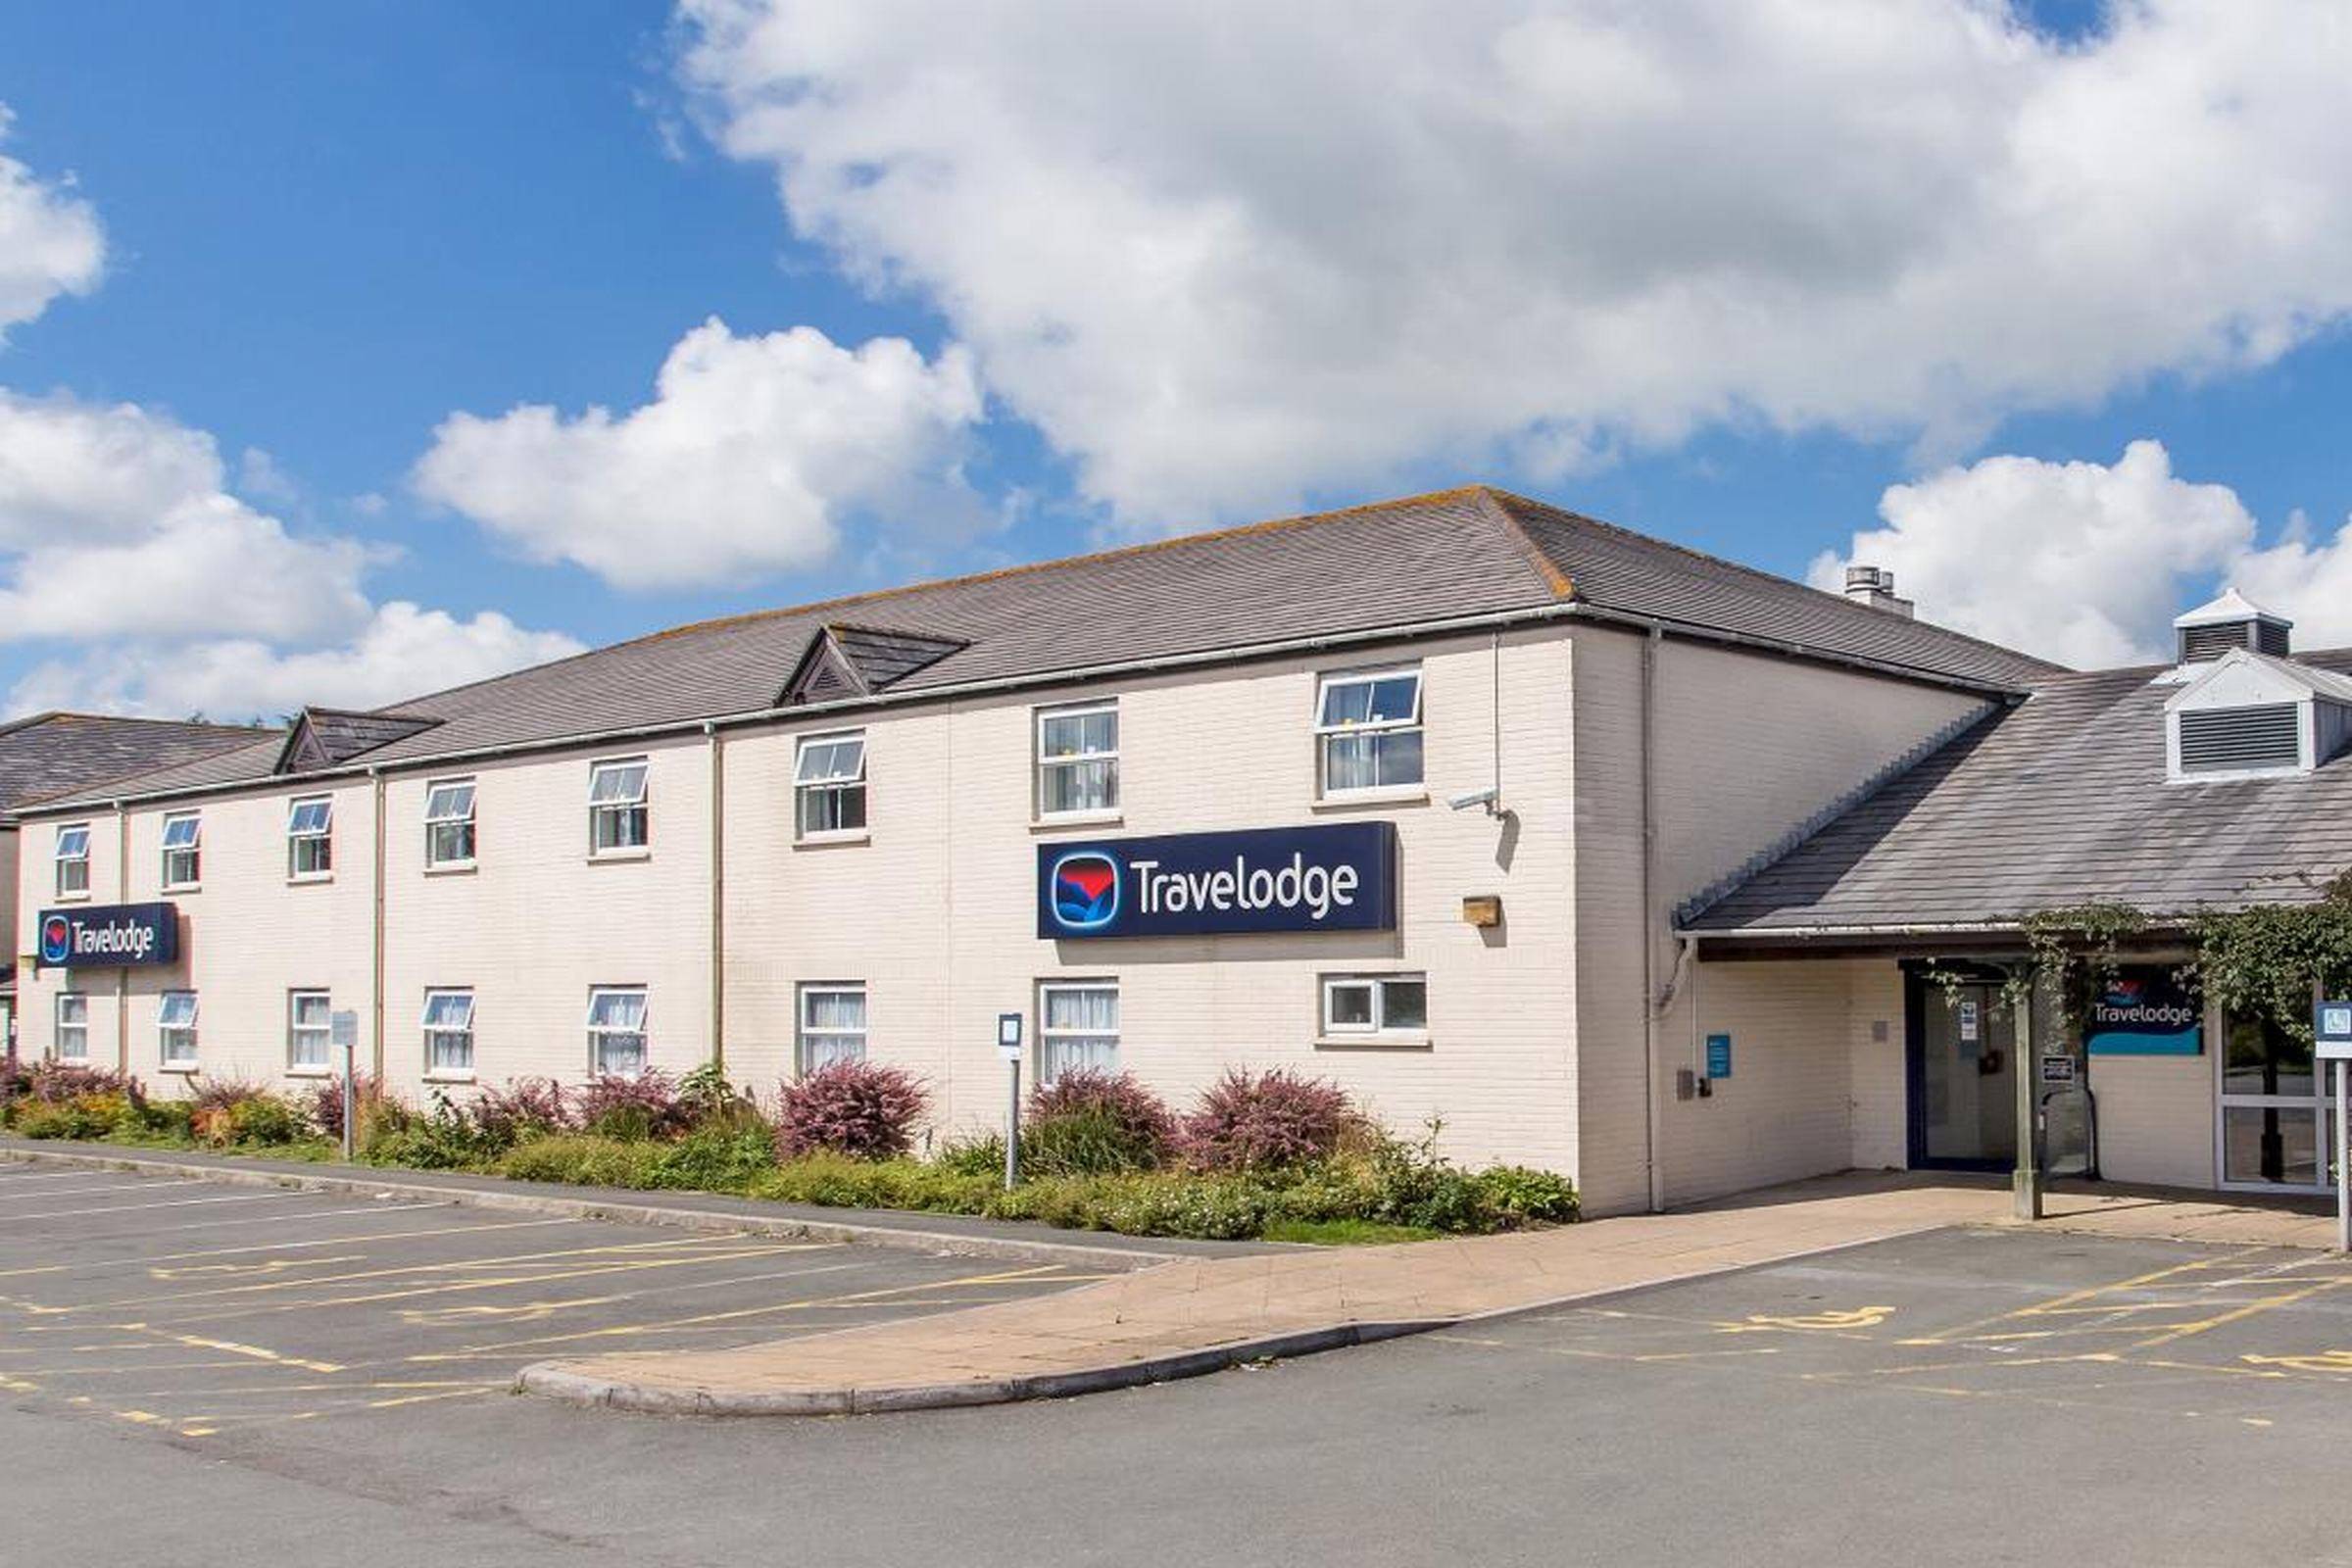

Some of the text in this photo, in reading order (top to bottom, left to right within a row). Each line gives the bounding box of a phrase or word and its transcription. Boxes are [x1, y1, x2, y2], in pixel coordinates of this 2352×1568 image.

[1129, 852, 1359, 920] Travelodge
[72, 918, 154, 959] Travelodge
[2095, 1003, 2192, 1026] Travelodge
